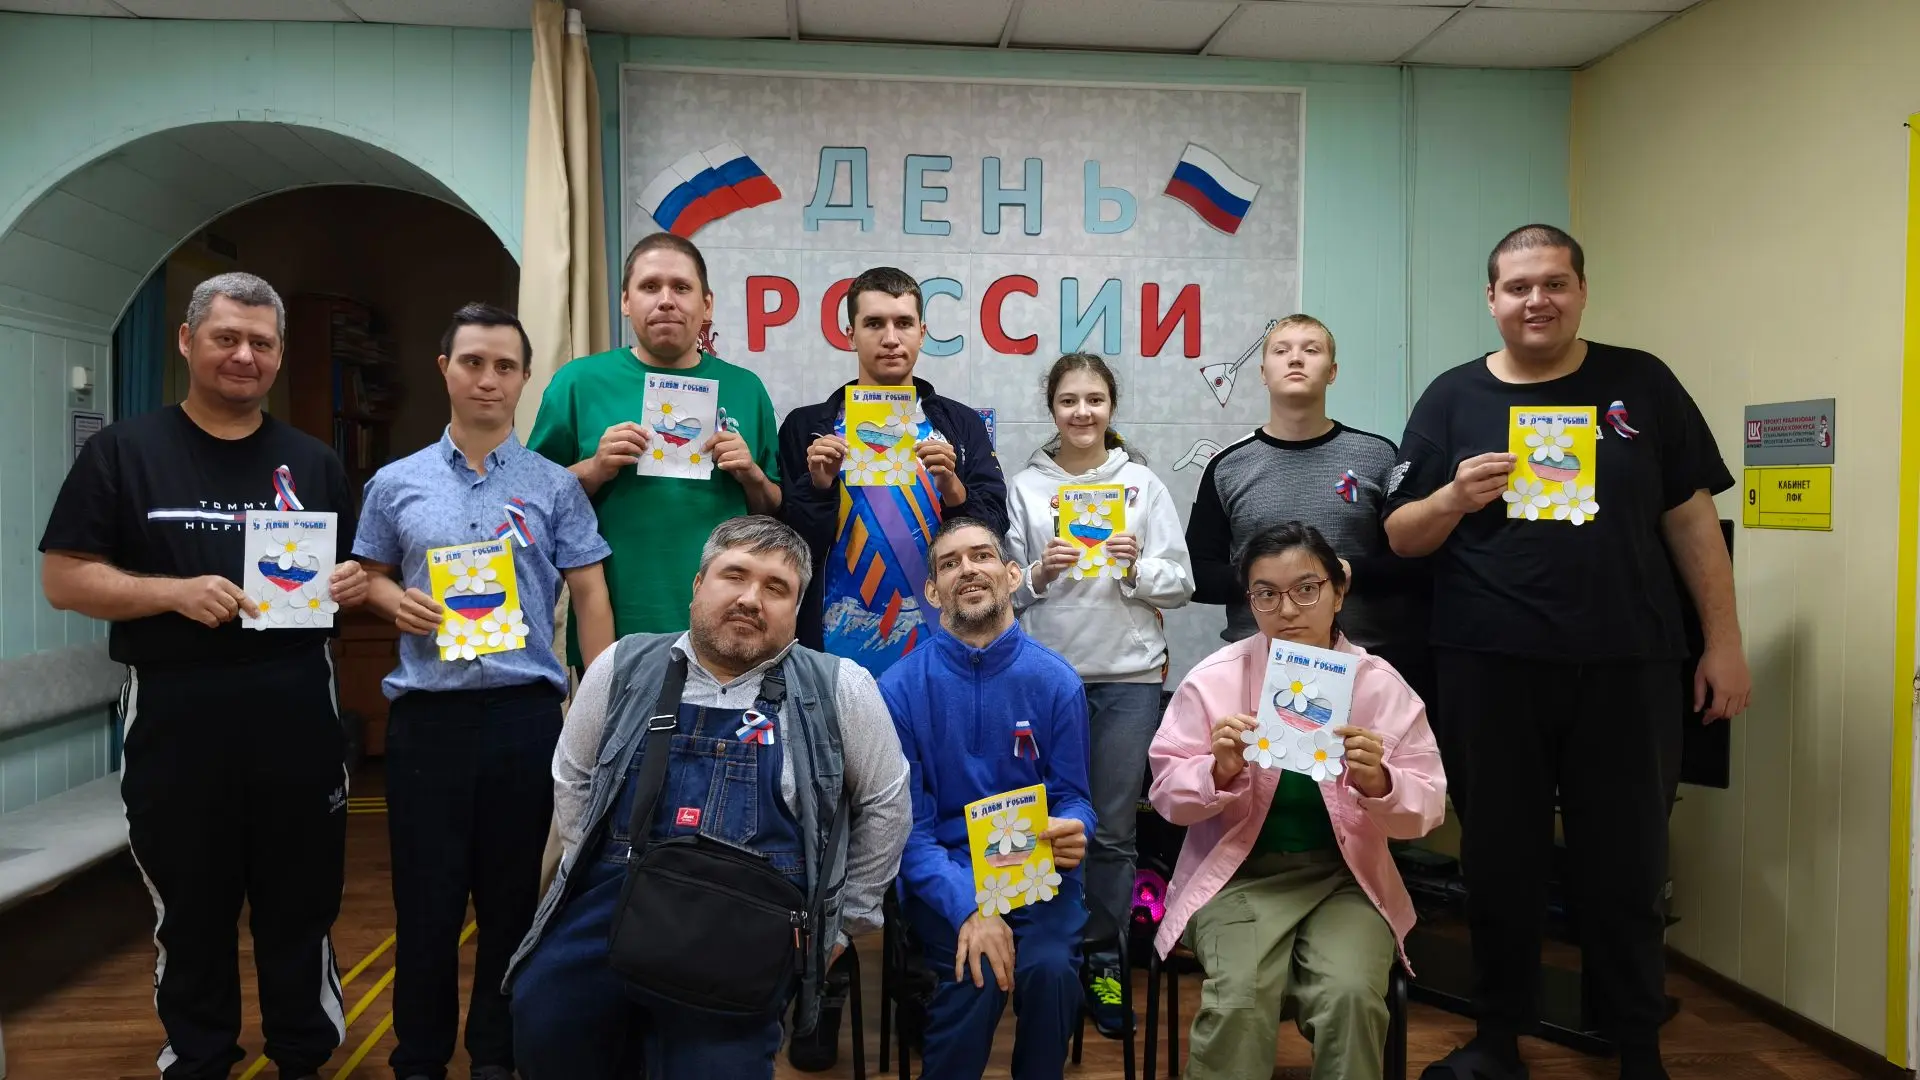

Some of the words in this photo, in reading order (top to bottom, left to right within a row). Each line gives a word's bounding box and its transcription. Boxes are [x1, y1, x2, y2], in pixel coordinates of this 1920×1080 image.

[803, 146, 1138, 236] ДЕНЬ
[1778, 480, 1811, 489] КАБИНЕТ
[1749, 489, 1756, 505] 9
[1786, 493, 1802, 502] ЛФК
[200, 500, 267, 511] TOMMY
[185, 521, 241, 532] HILFI
